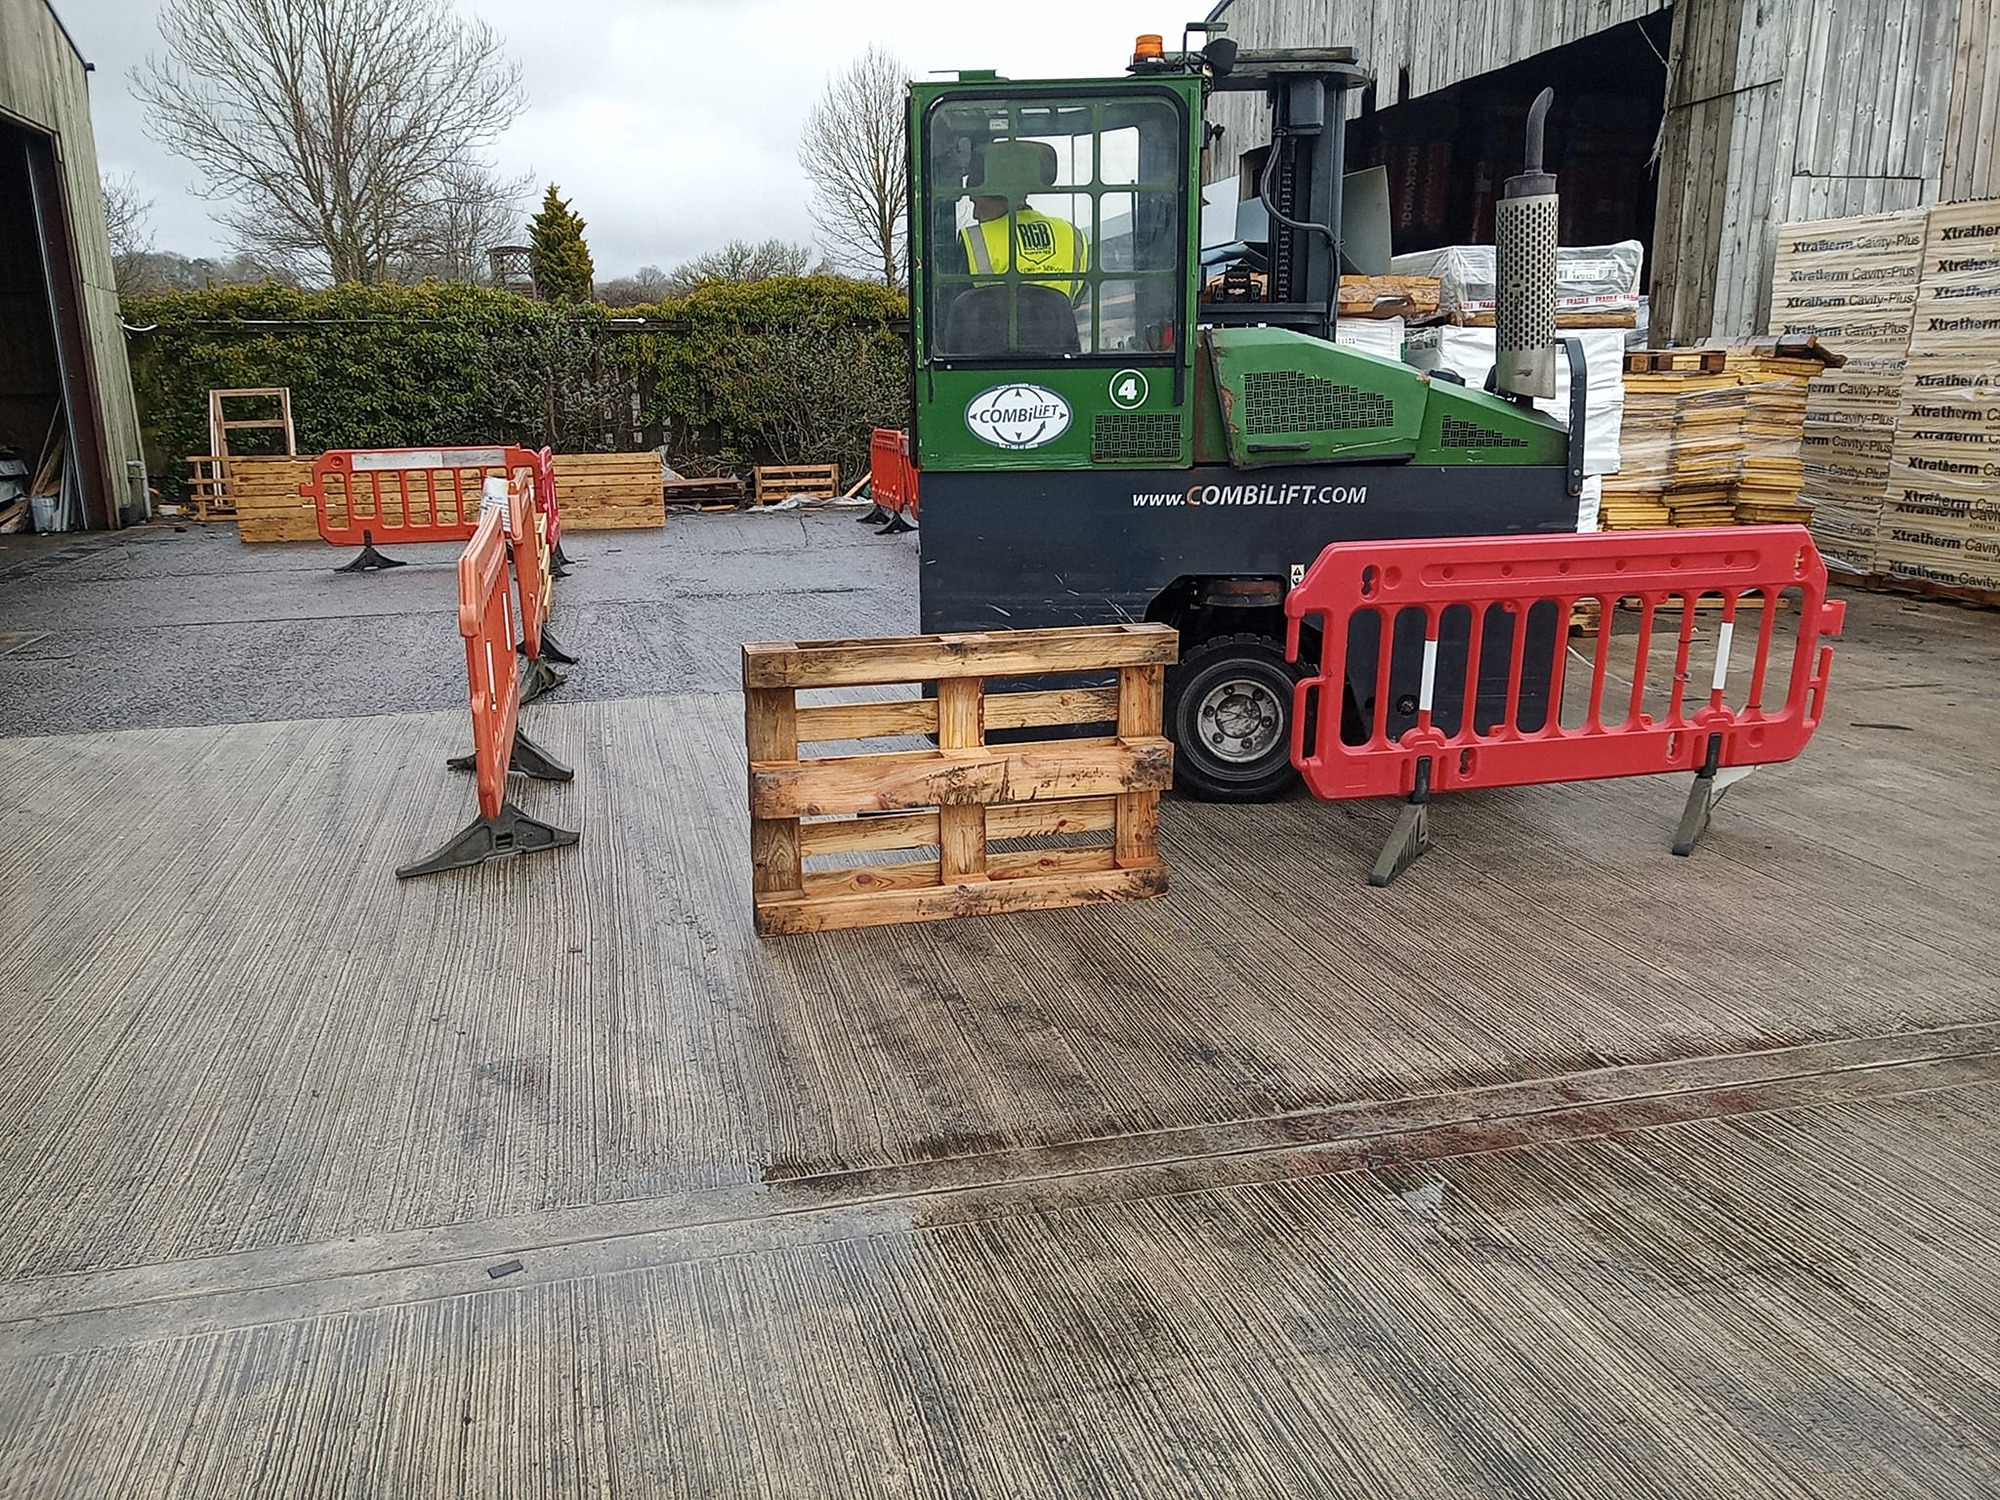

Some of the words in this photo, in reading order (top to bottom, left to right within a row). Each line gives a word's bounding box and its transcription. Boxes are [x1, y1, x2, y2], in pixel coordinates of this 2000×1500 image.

[1017, 223, 1051, 247] RGB
[1792, 239, 1853, 253] Xtratherm
[1857, 233, 1920, 250] Cavity-Plus
[1789, 269, 1848, 282] Xtratherm
[1852, 265, 1915, 281] Cavity-Plus
[1786, 296, 1845, 308] Xtratherm
[1849, 292, 1914, 307] Cavity-Plus
[1118, 379, 1138, 400] 4
[1838, 383, 1900, 398] Cavity-Plus
[1833, 411, 1894, 427] Cavity-Plus
[1911, 404, 1982, 421] Xtratherm
[1832, 435, 1893, 453] Cavity-Plus
[1829, 463, 1889, 480] Cavity-Plus
[1908, 457, 1979, 475] Xtratherm
[1891, 529, 1960, 549] Xtratherm
[1887, 560, 1955, 582] Xtratherm
